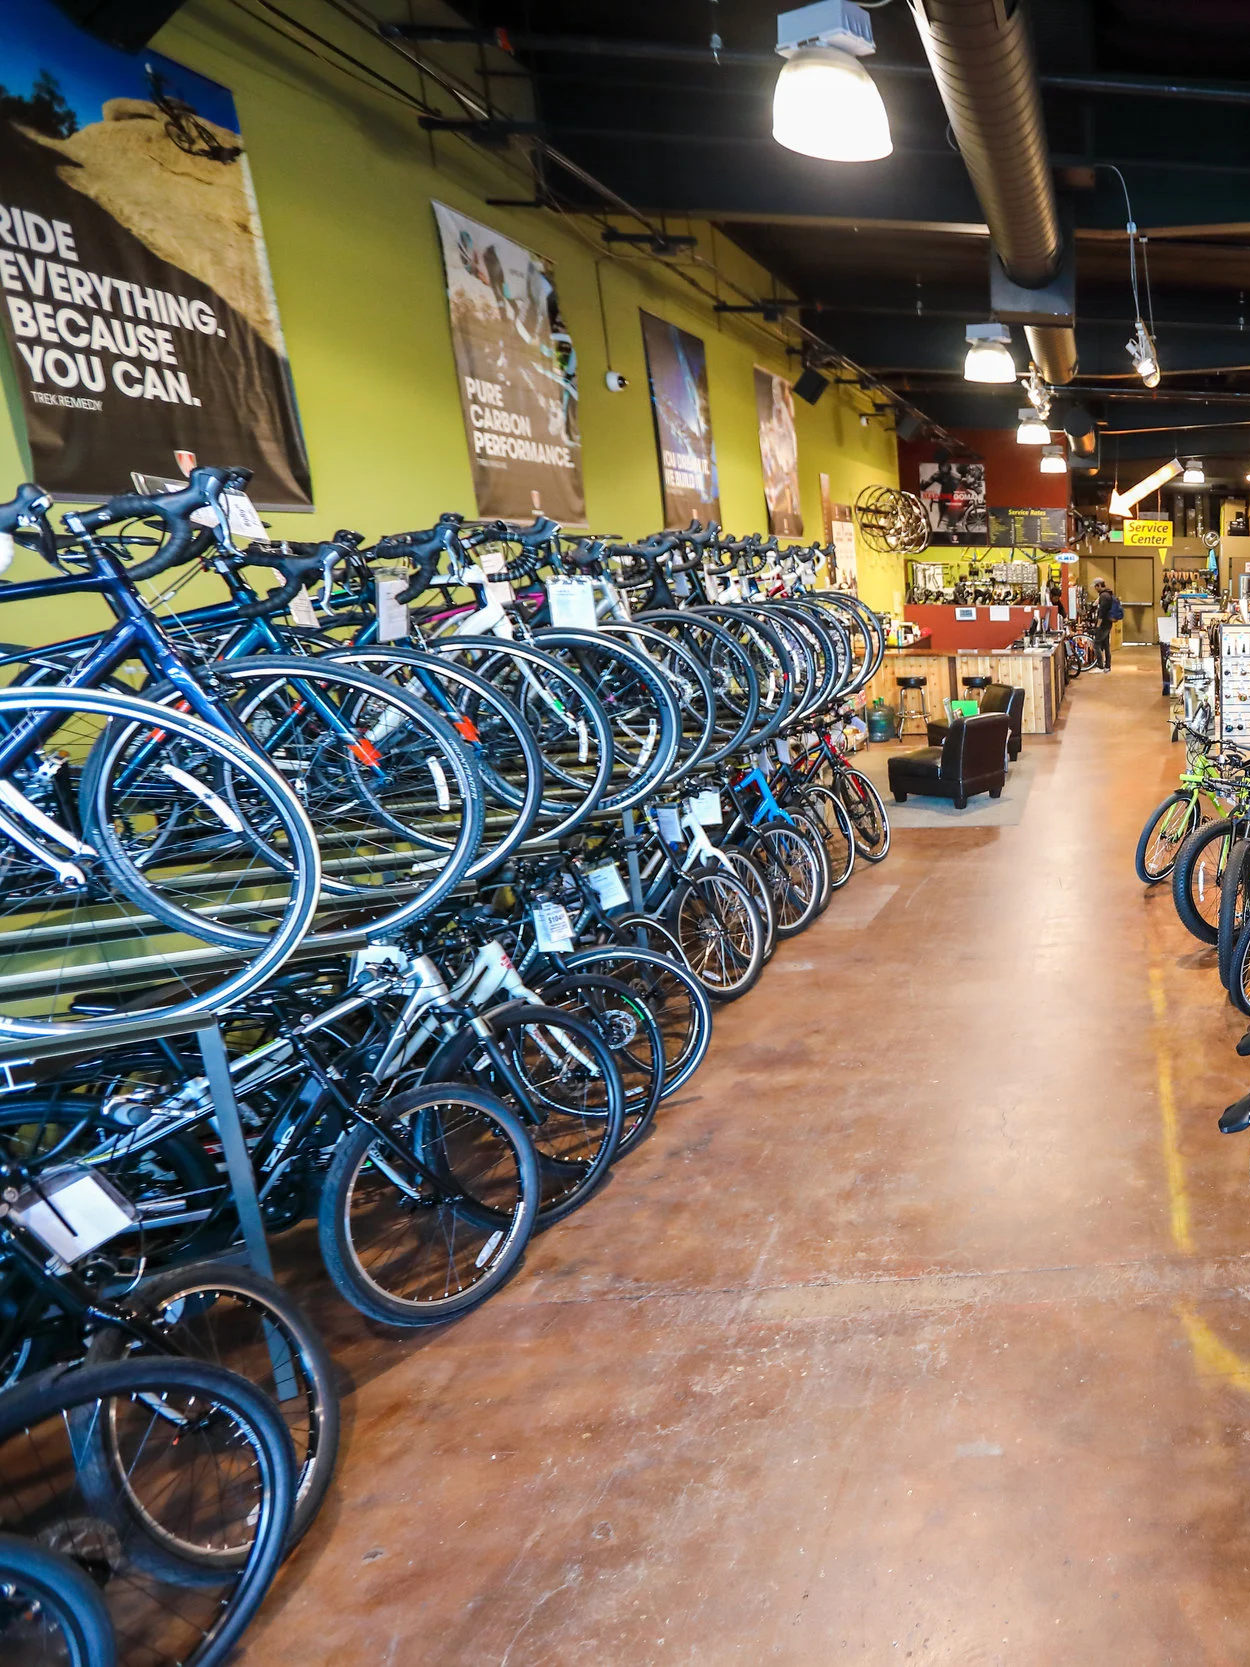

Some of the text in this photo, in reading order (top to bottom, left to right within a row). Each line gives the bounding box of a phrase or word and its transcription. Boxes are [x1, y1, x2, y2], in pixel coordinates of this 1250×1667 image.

[0, 204, 79, 262] RIDE
[0, 251, 227, 338] EVERYTHING.
[6, 296, 178, 365] BECAUSE
[17, 343, 203, 407] YOU CAN.
[464, 376, 504, 407] PURE
[30, 391, 103, 411] TREK REMEDY
[470, 404, 532, 438] CARBON
[473, 430, 575, 468] PERFORMANCE.
[1128, 521, 1169, 533] Service
[1131, 534, 1167, 545] Center
[260, 1125, 296, 1172] IZIP
